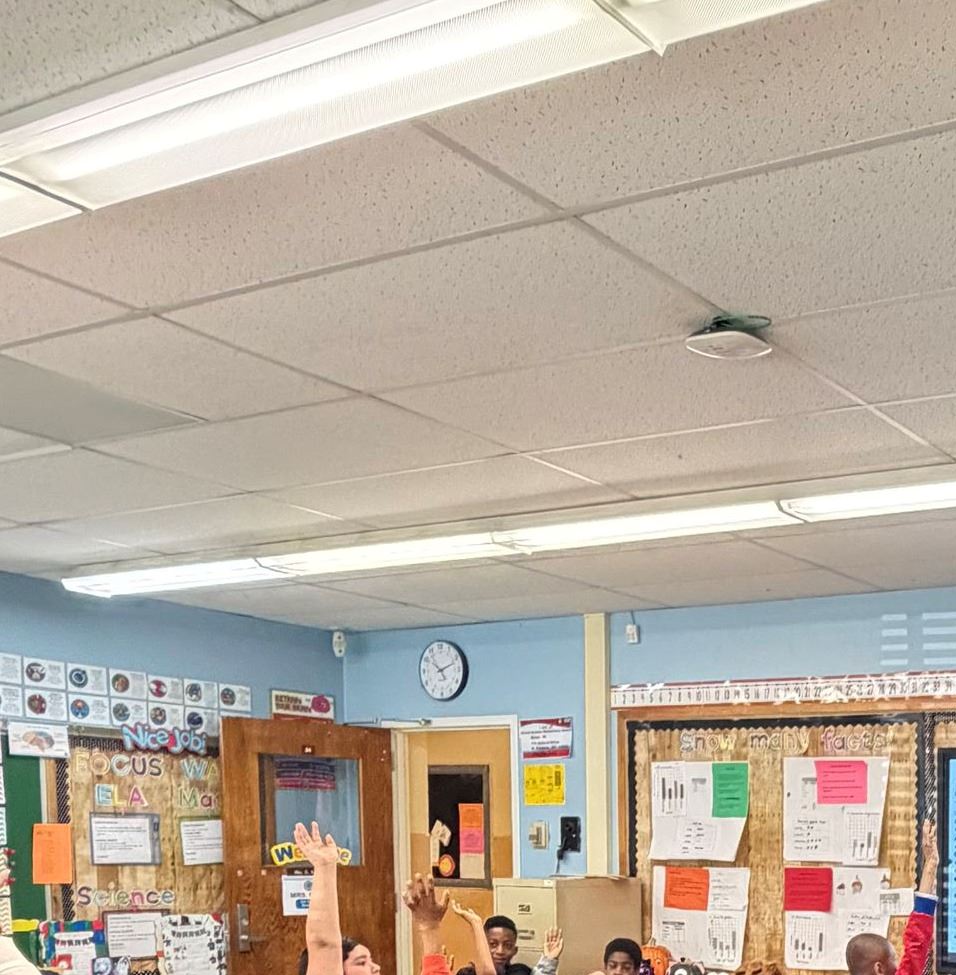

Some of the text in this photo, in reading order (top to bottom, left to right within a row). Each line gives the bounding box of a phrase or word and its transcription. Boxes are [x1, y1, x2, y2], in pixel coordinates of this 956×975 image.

[695, 691, 702, 702] 10
[724, 690, 730, 700] 13
[744, 689, 750, 700] 15
[764, 687, 770, 699] 17
[804, 686, 810, 698] 21
[814, 685, 821, 697] 22
[888, 683, 897, 694] 29
[121, 722, 168, 750] Nice
[680, 731, 736, 751] Snow
[750, 731, 809, 753] many
[74, 752, 164, 777] FOCUS
[95, 784, 148, 806] ELA
[76, 882, 176, 906] Science
